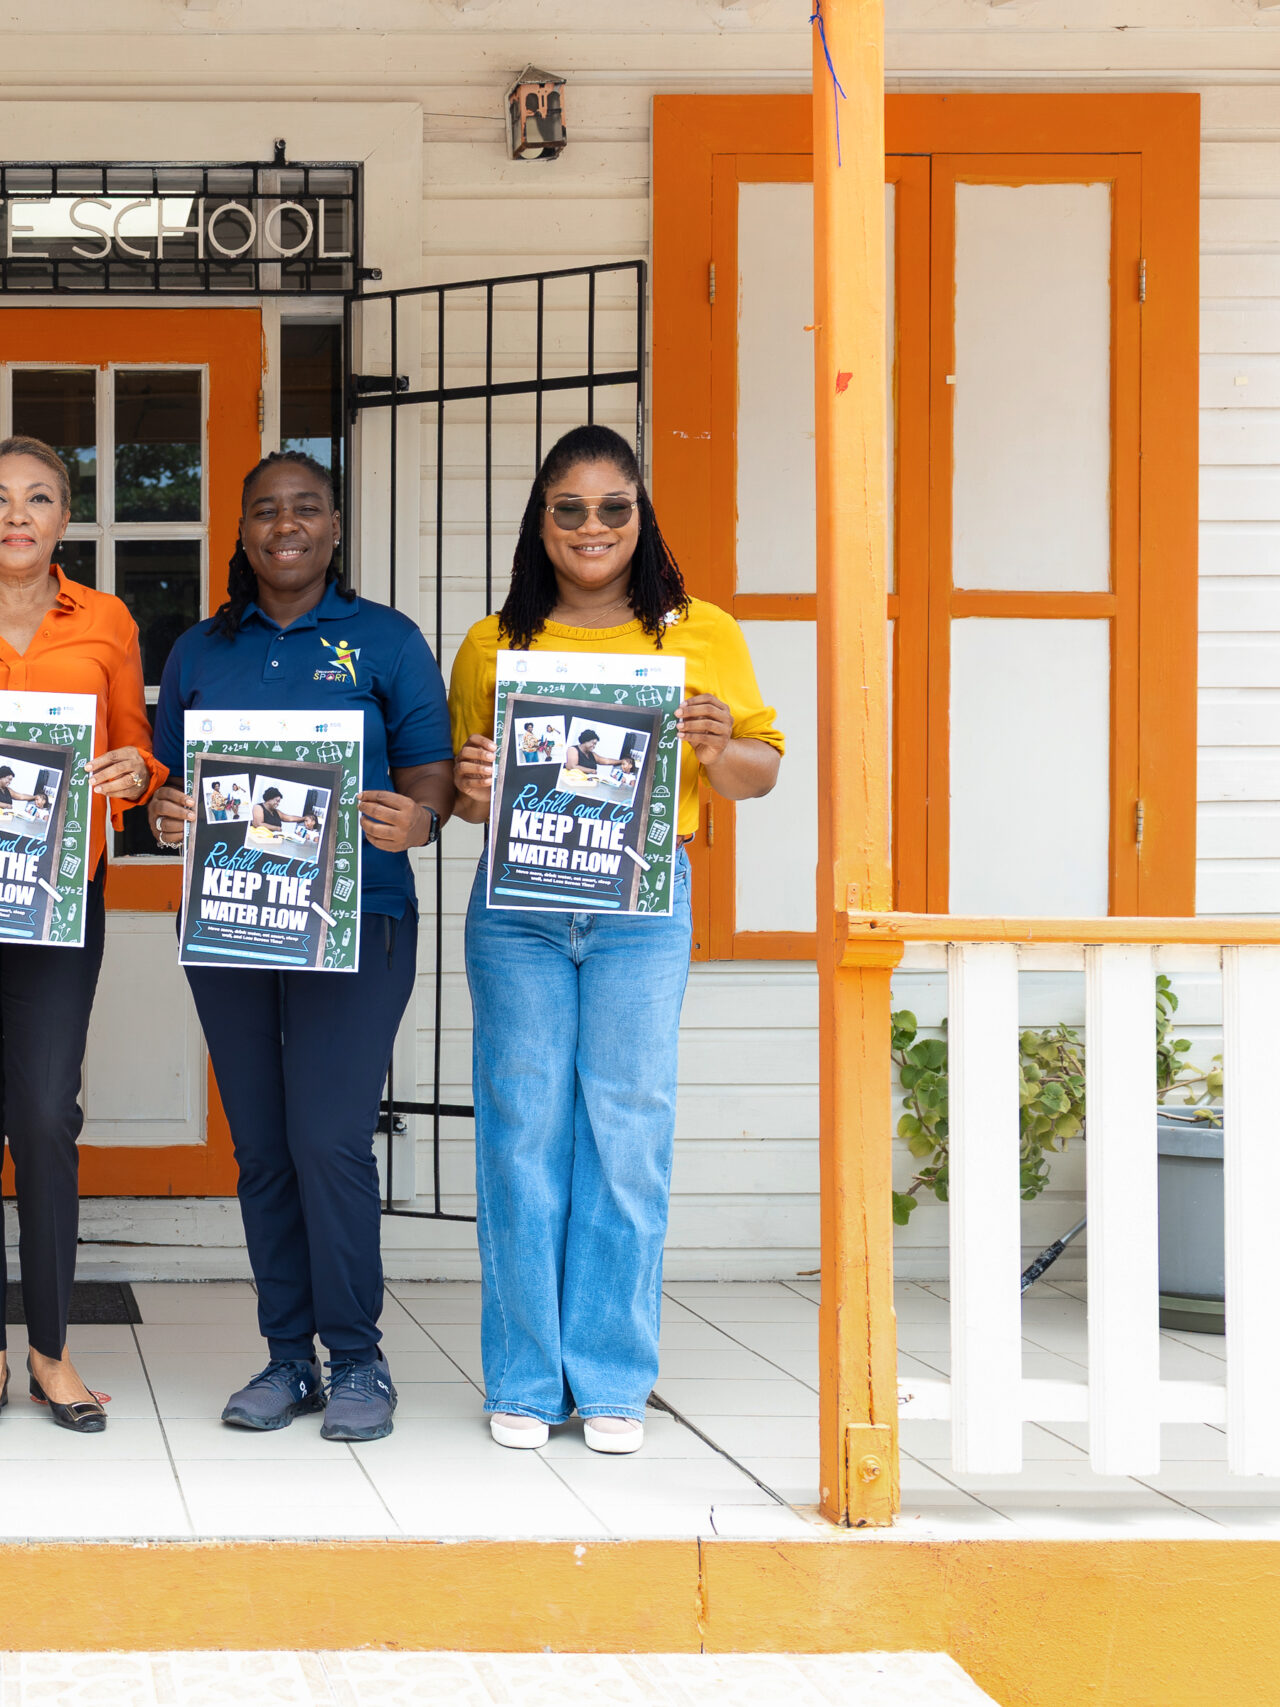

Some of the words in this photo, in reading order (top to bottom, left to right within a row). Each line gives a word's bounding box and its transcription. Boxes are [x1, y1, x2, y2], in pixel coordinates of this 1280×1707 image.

[69, 197, 352, 260] SCHOOL
[537, 684, 565, 694] 2+2=4
[222, 742, 249, 753] 2+2=4
[512, 784, 576, 820] Refill
[573, 800, 608, 820] and
[610, 799, 634, 831] Go
[25, 833, 48, 863] Go
[510, 808, 574, 844] KEEP
[577, 817, 626, 851] THE
[203, 842, 264, 877] Refill
[262, 857, 295, 876] and
[296, 856, 319, 887] Go
[508, 841, 569, 869] WATER
[570, 850, 622, 875] FLOW
[201, 866, 262, 900] KEEP
[266, 874, 312, 907] THE
[201, 899, 259, 925] WATER
[260, 906, 308, 931] FLOW
